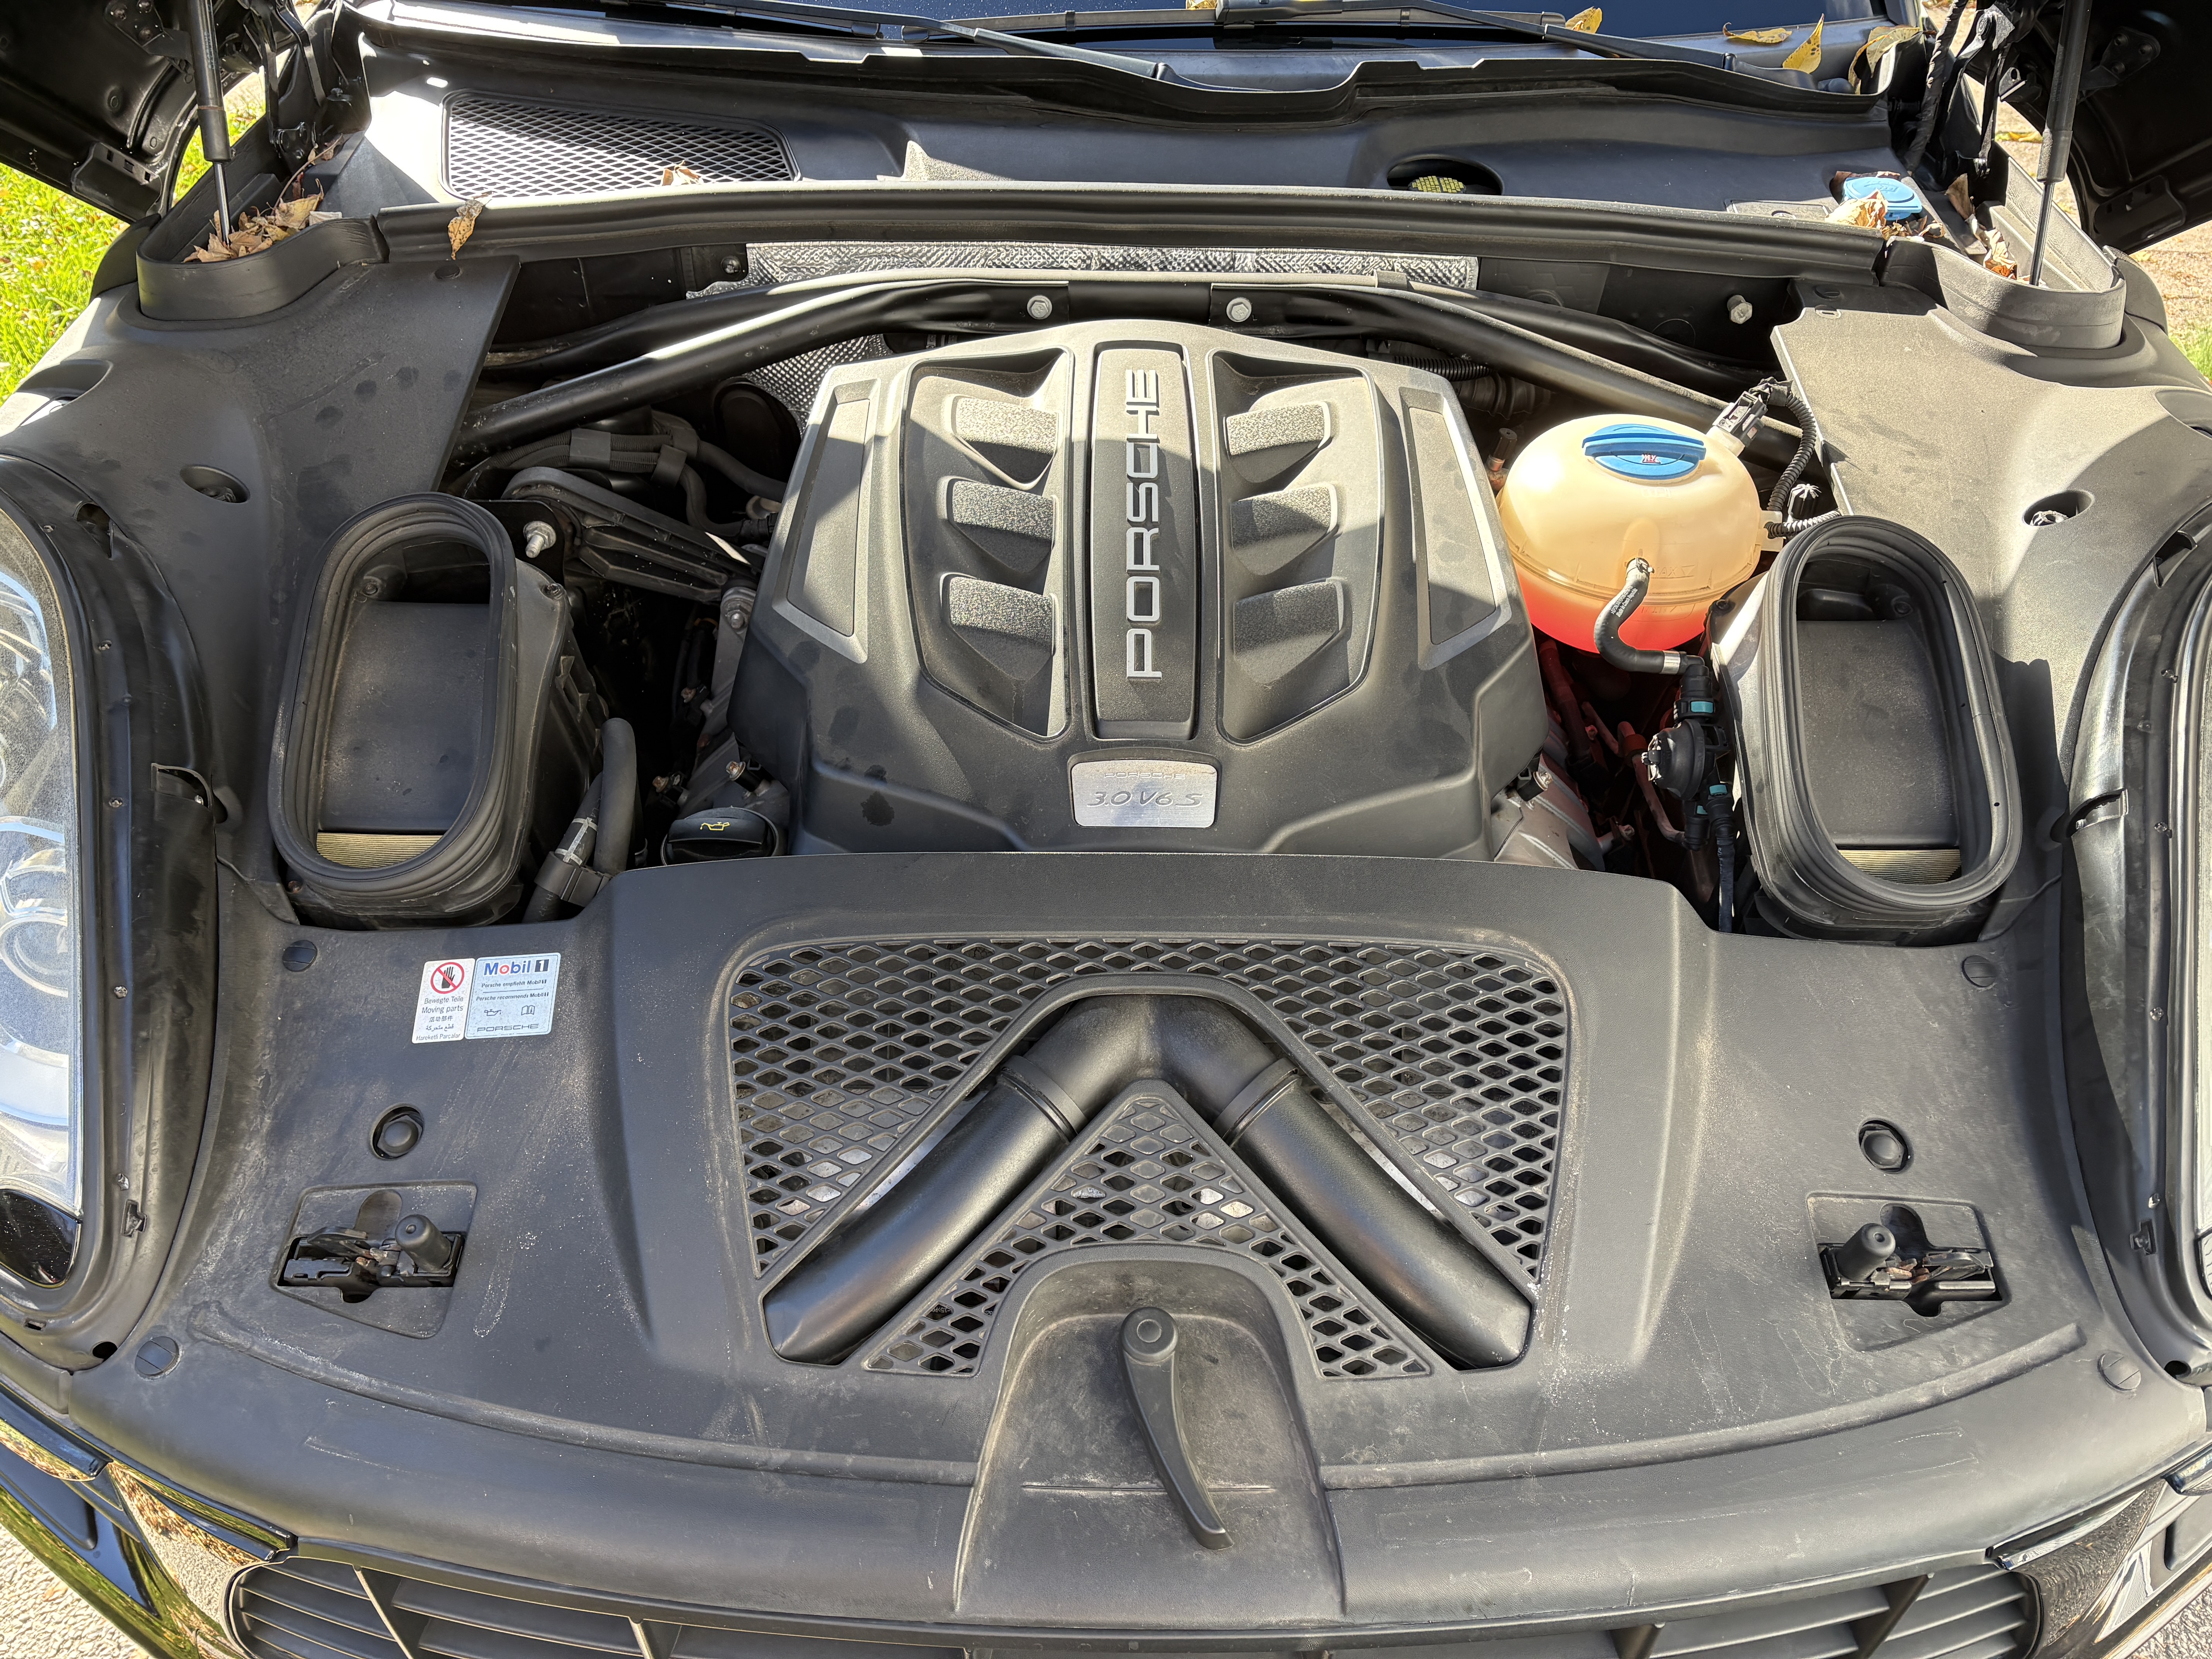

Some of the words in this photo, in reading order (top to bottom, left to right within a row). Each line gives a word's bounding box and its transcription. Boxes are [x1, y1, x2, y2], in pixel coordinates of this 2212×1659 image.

[1126, 369, 1162, 681] PORSCHE
[1104, 771, 1186, 780] PORSCHE
[1086, 791, 1133, 807] 3.0
[1139, 791, 1173, 807] V6
[1175, 793, 1204, 808] S
[484, 960, 531, 975] Mobil
[446, 1005, 464, 1013] parts
[477, 1024, 539, 1032] PORSCHE
